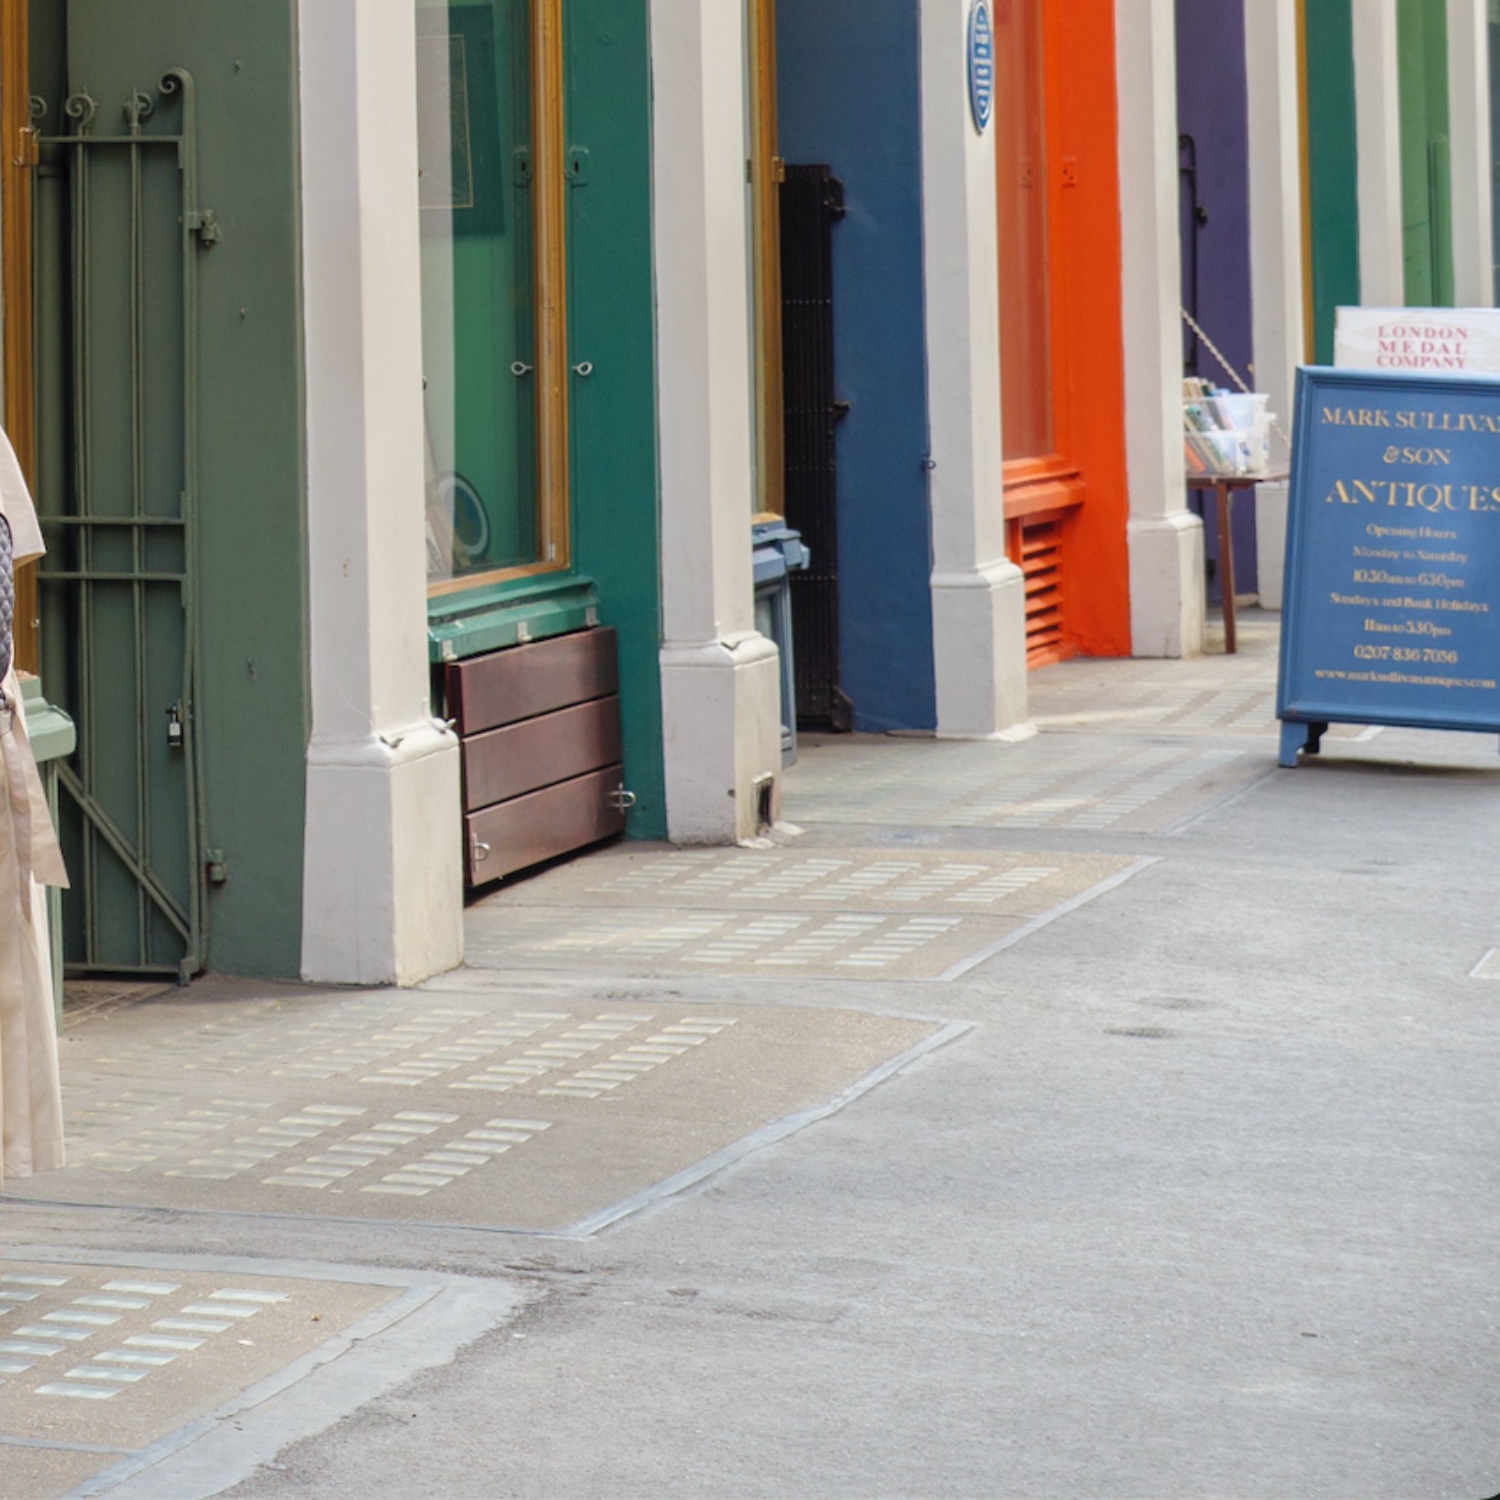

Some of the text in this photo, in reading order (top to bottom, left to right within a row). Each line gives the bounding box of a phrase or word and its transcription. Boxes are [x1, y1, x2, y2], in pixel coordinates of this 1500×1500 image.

[1378, 326, 1468, 339] LONDON
[1378, 340, 1468, 355] MEDAL
[1376, 356, 1467, 369] COMPANY
[1321, 406, 1500, 433] MARK SULLIVA
[1366, 523, 1457, 540] Opening Hours
[1354, 644, 1390, 660] 0207
[1392, 646, 1420, 662] 836
